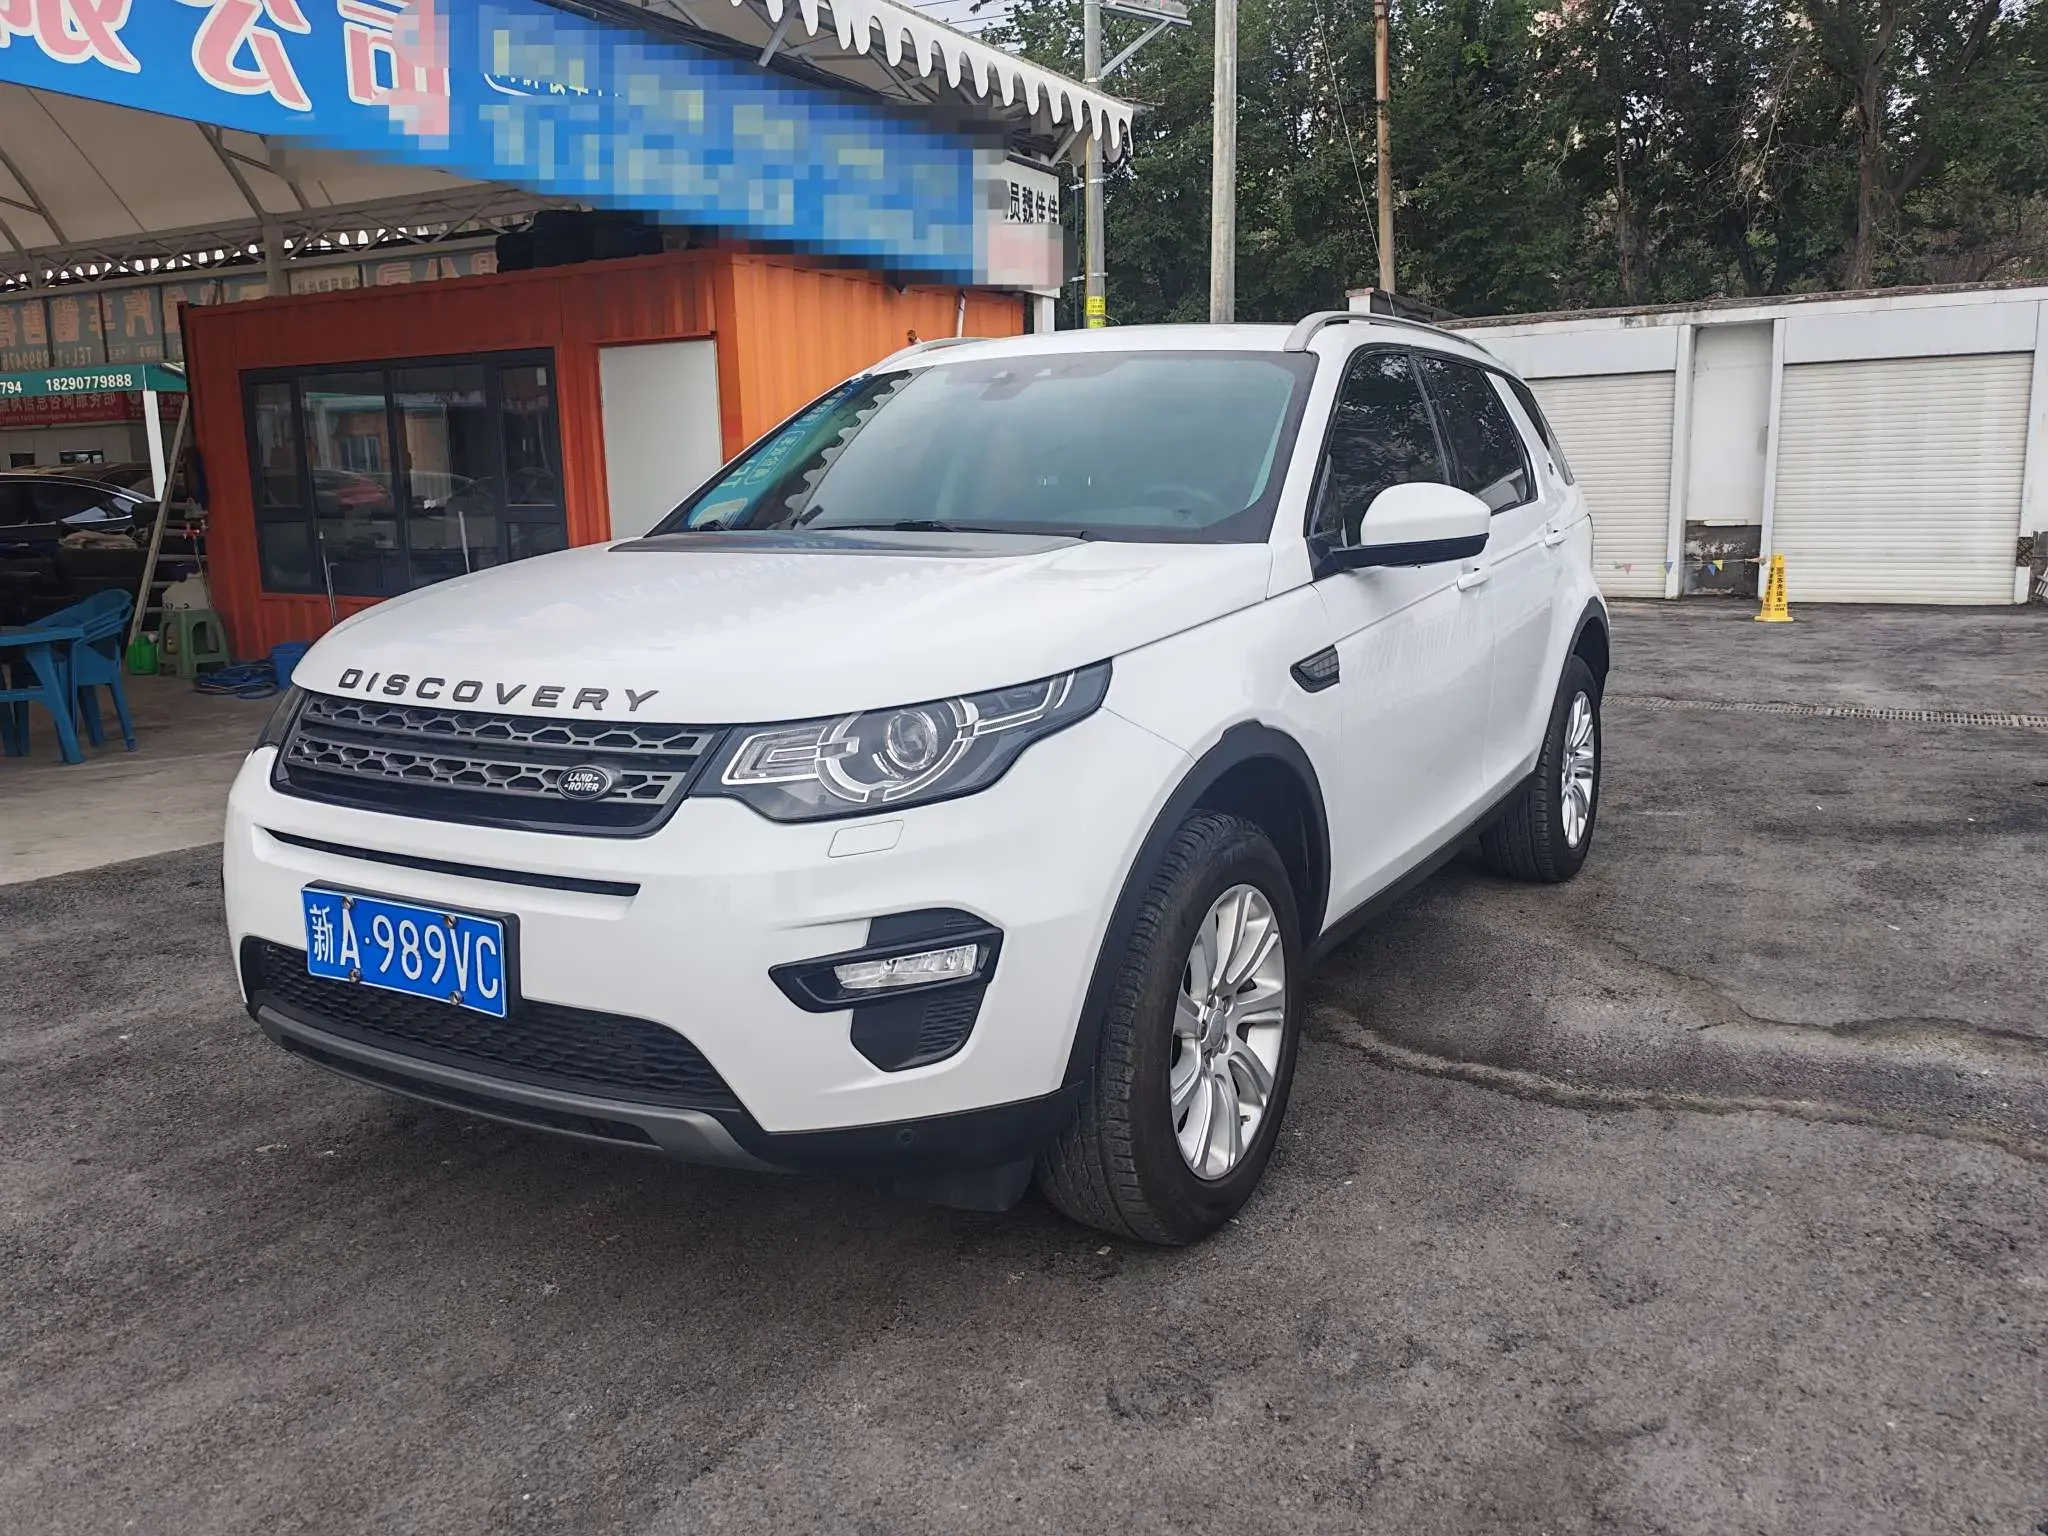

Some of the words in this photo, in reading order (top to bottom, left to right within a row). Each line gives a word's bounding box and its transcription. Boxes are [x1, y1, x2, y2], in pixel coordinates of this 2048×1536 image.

[1005, 182, 1058, 224] 员魏佳佳
[46, 373, 132, 392] 18290779888
[338, 668, 660, 711] DISCOVERY
[567, 772, 593, 782] LAND
[567, 782, 599, 792] ROVER
